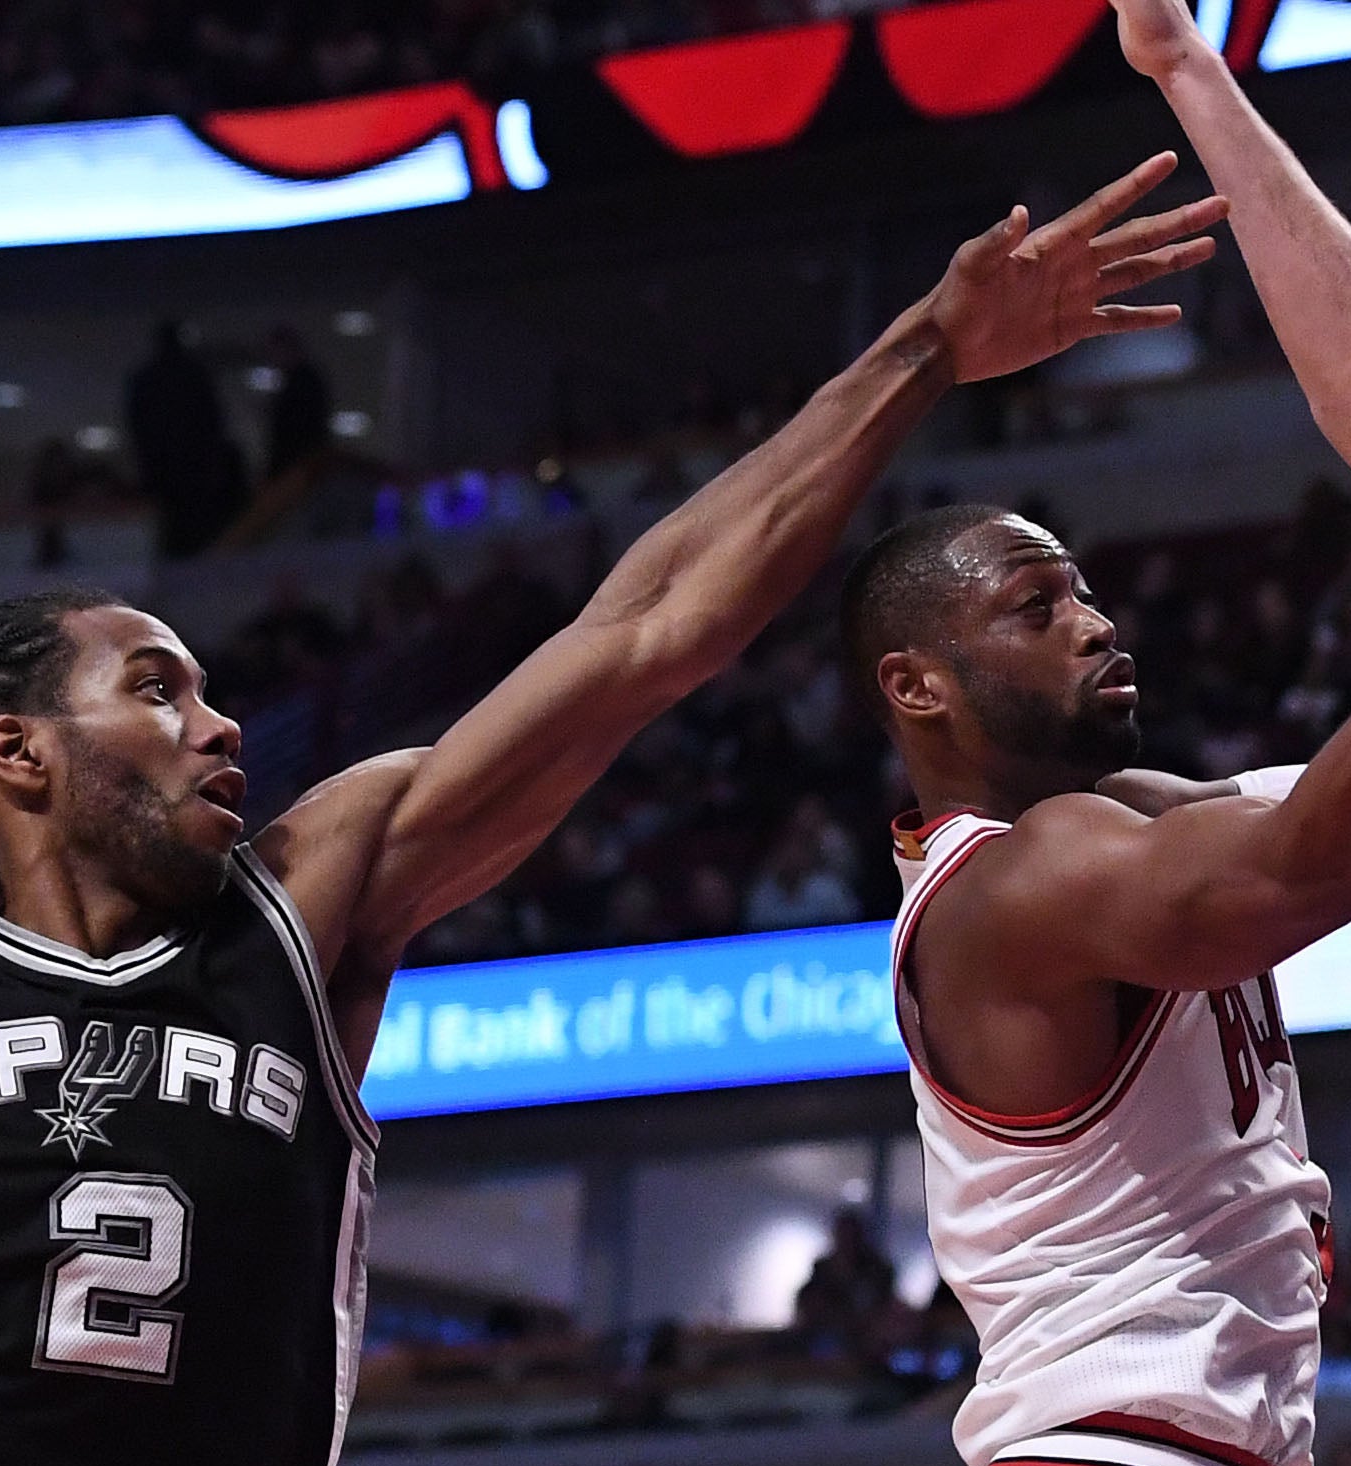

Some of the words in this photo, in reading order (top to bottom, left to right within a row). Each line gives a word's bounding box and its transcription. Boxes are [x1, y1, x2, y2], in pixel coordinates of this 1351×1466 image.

[428, 987, 570, 1074] Bank
[574, 978, 636, 1059] of
[644, 972, 736, 1049] the
[31, 1171, 195, 1386] 2
